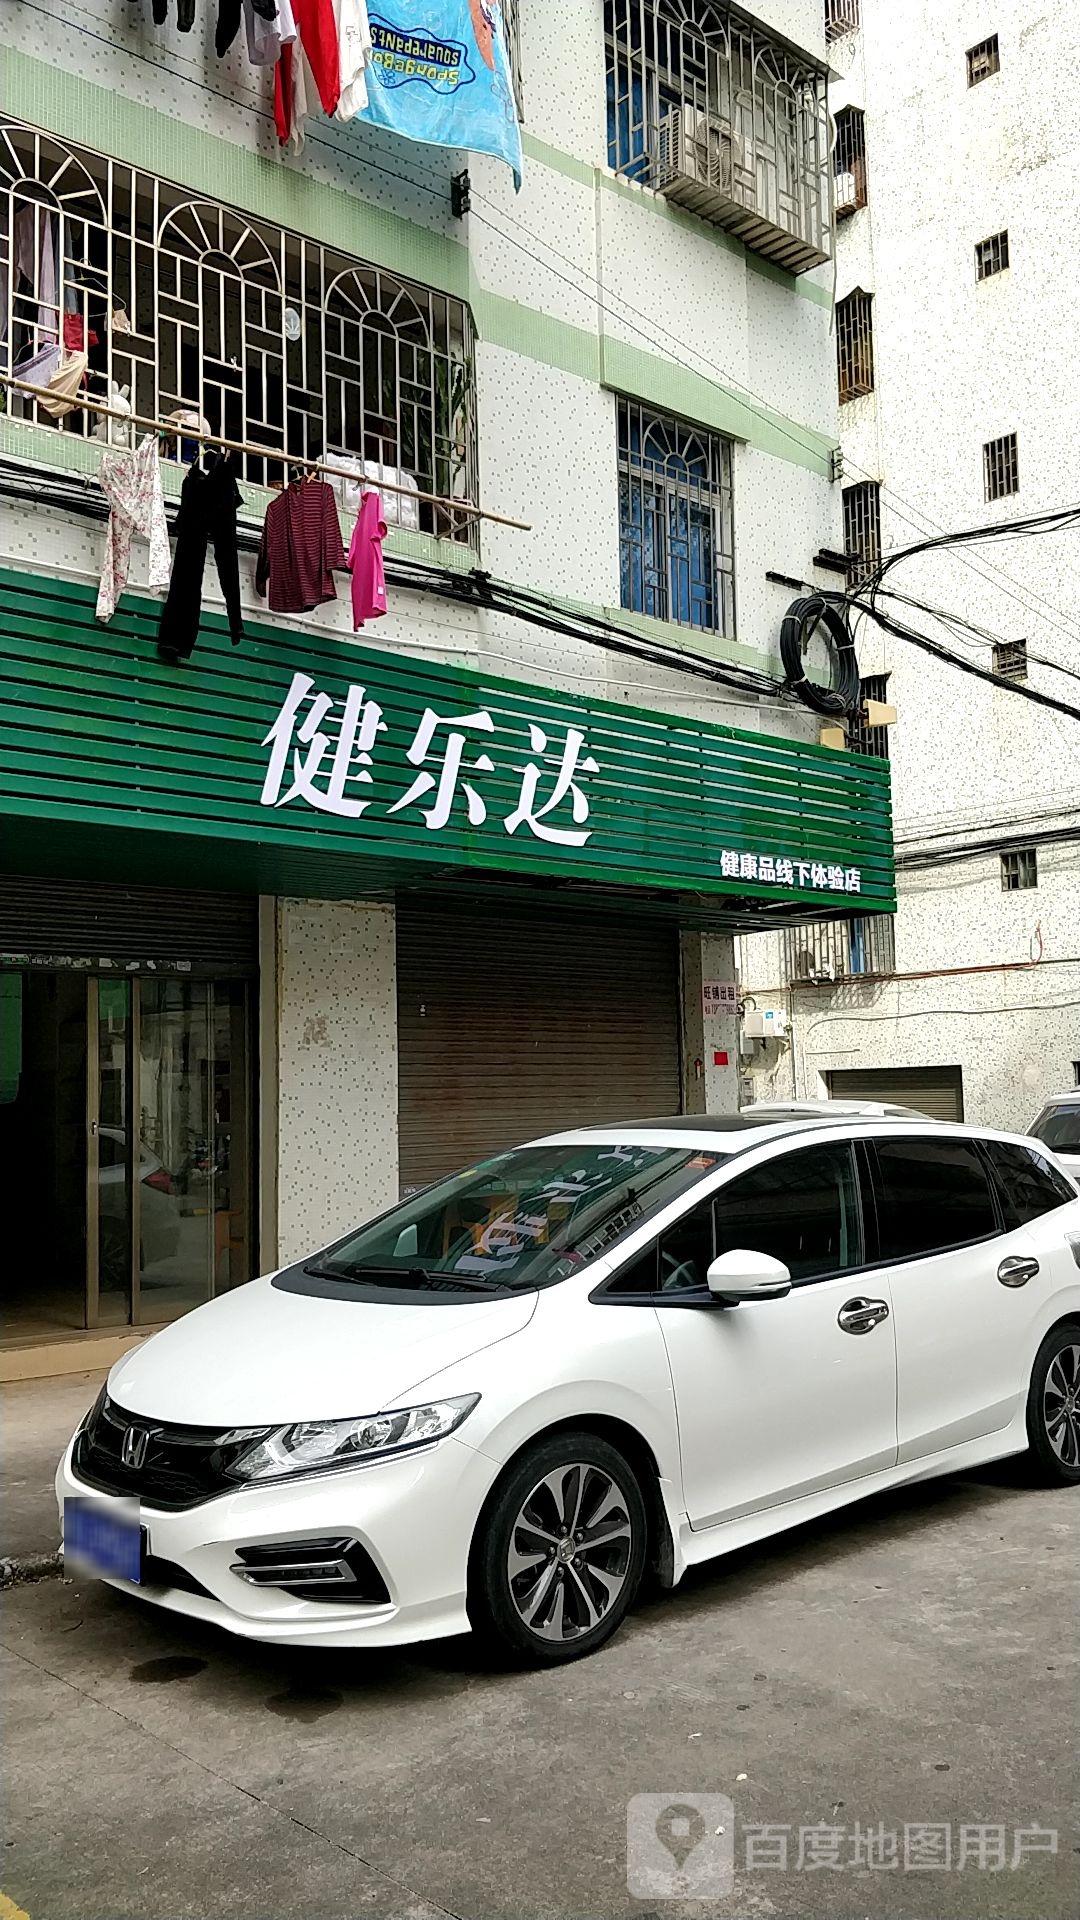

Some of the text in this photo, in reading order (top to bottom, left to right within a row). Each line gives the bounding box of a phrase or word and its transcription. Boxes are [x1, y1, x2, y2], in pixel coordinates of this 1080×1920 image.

[260, 672, 600, 847] 健乐达
[720, 850, 861, 893] 健康品线下体验店
